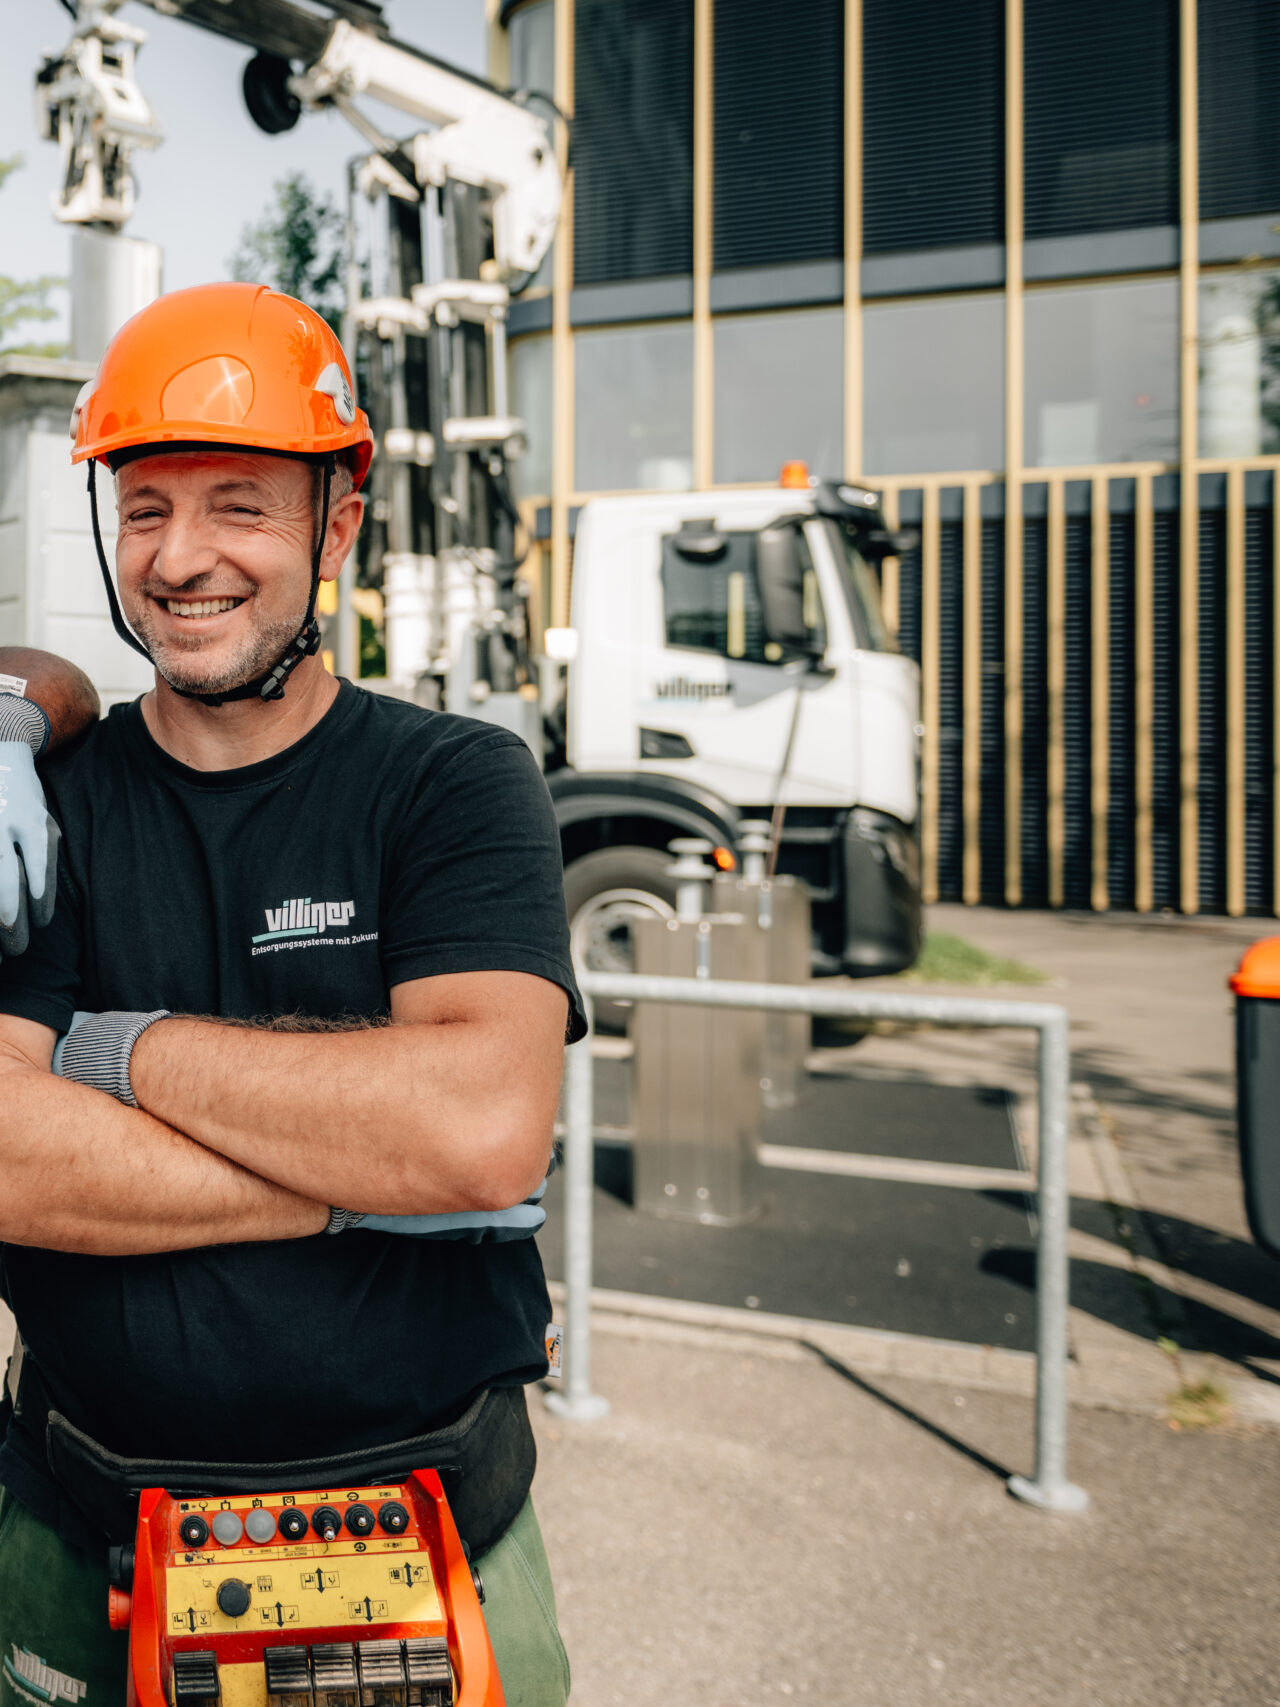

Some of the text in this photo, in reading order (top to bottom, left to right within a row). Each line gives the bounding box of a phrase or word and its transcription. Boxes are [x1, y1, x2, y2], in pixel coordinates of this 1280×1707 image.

[264, 897, 356, 933] villiger
[251, 938, 334, 956] Entsorgungssysteme
[335, 936, 350, 946] mit
